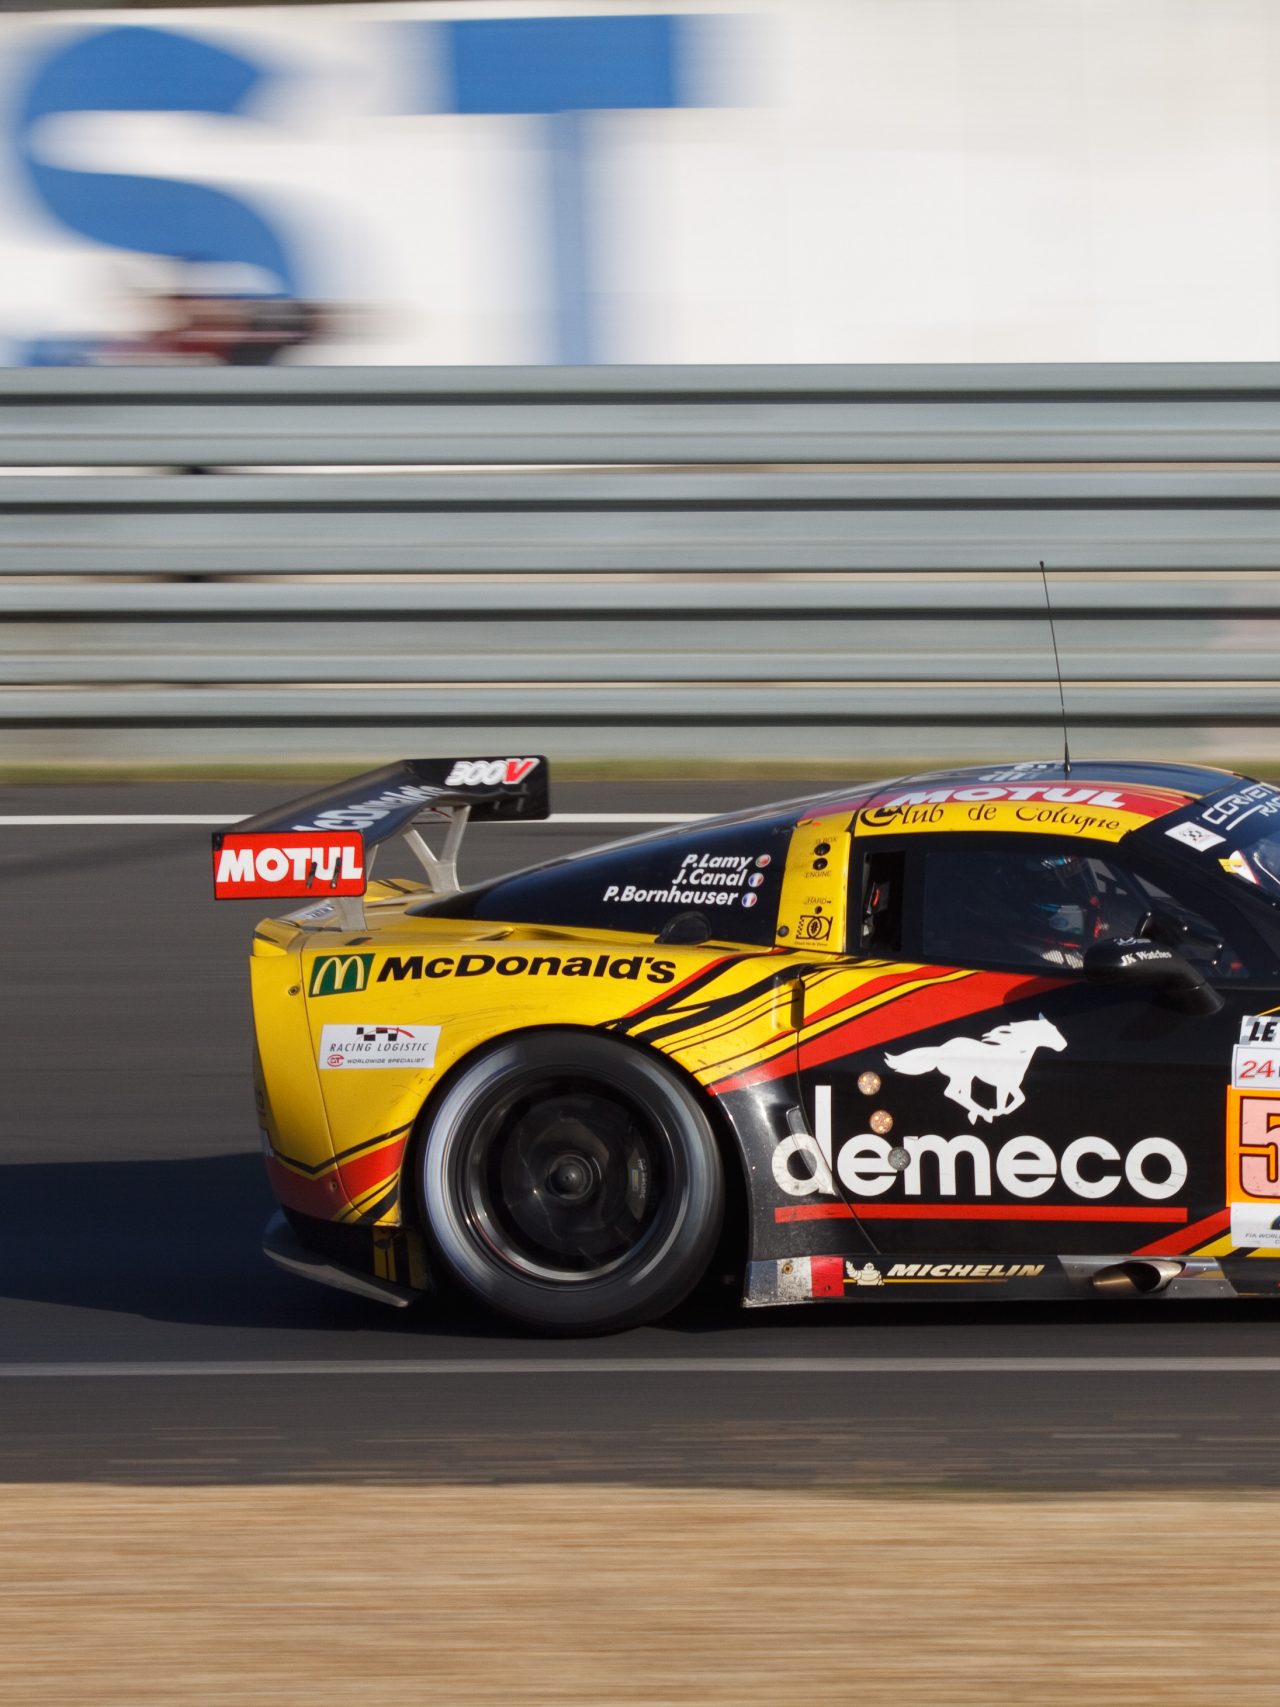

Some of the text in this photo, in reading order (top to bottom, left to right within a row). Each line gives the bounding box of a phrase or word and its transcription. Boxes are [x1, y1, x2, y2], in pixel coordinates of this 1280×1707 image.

[445, 758, 539, 786] 300V
[885, 787, 1125, 809] MOTUL
[860, 803, 1120, 834] Club de Cologne
[216, 847, 363, 882] MOTUL
[681, 853, 753, 872] P.Lamy
[672, 869, 748, 886] J.Canal
[603, 886, 738, 906] P.Bornhauser
[377, 954, 676, 983] McDonald's
[1248, 1022, 1278, 1042] LE
[330, 1042, 429, 1052] RACING LOGISTIC
[1240, 1060, 1276, 1079] 24
[771, 1085, 1188, 1200] demeco
[886, 1263, 1046, 1278] MICHELIN
